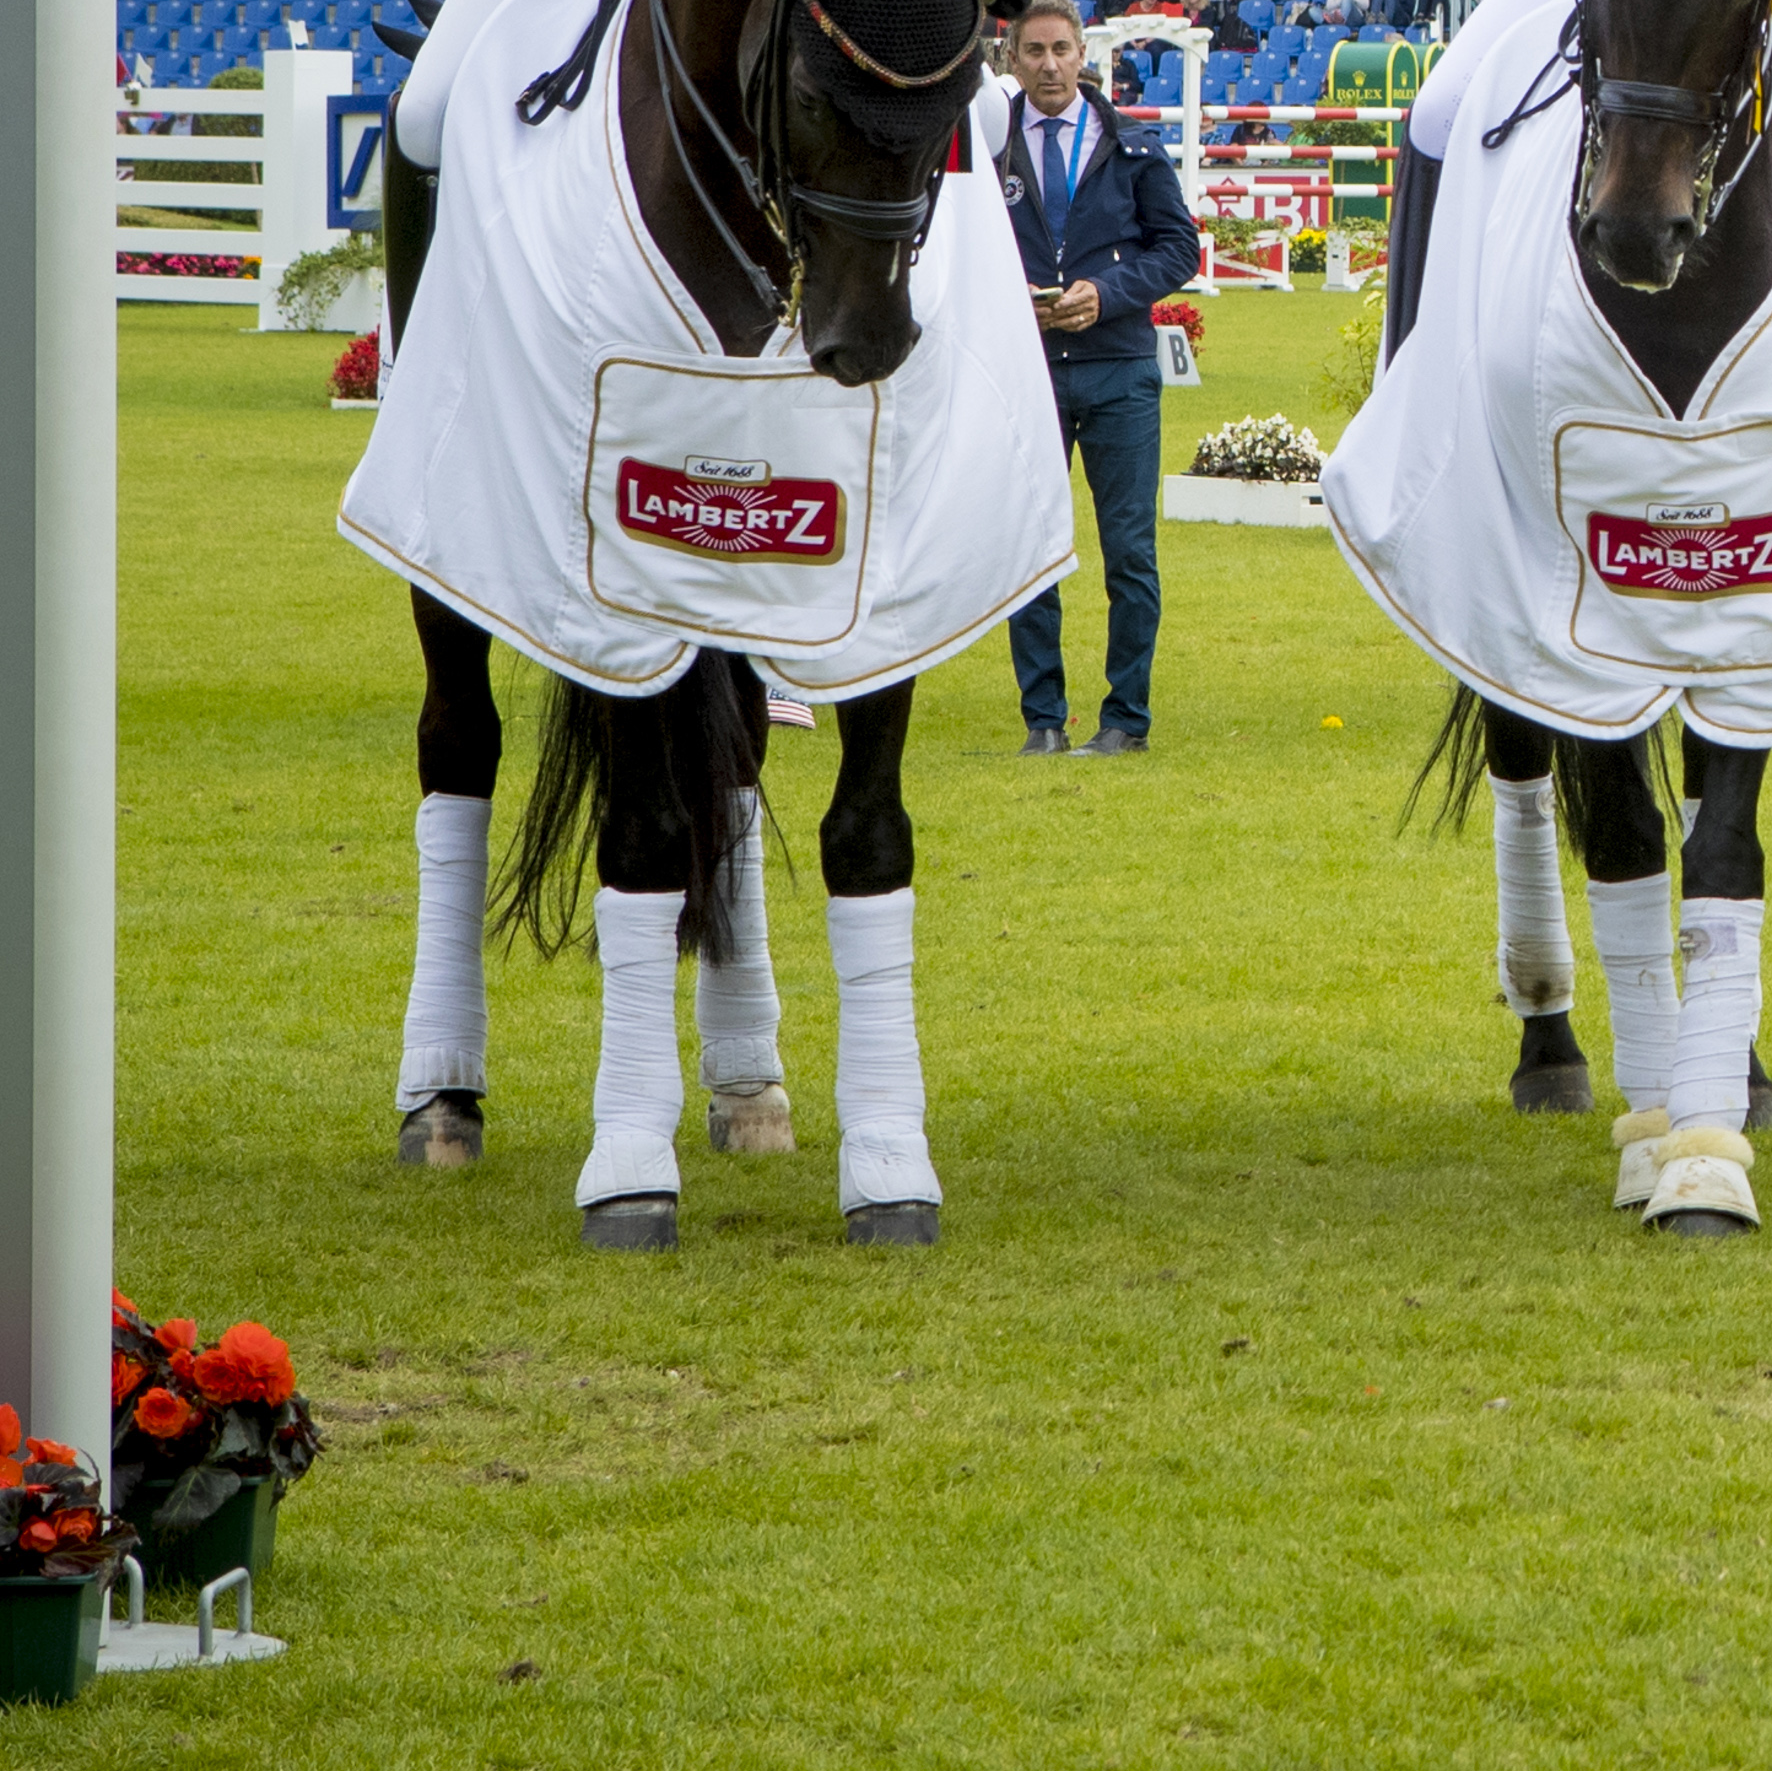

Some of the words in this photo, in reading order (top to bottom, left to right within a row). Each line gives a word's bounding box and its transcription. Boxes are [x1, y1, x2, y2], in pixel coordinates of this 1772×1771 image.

[1336, 89, 1383, 100] ROLEX
[1168, 334, 1189, 375] B
[694, 460, 722, 476] Seit
[723, 465, 755, 478] 1688
[628, 478, 826, 545] LAMBERTZ
[1655, 508, 1681, 521] Seit
[1683, 506, 1714, 520] 1688
